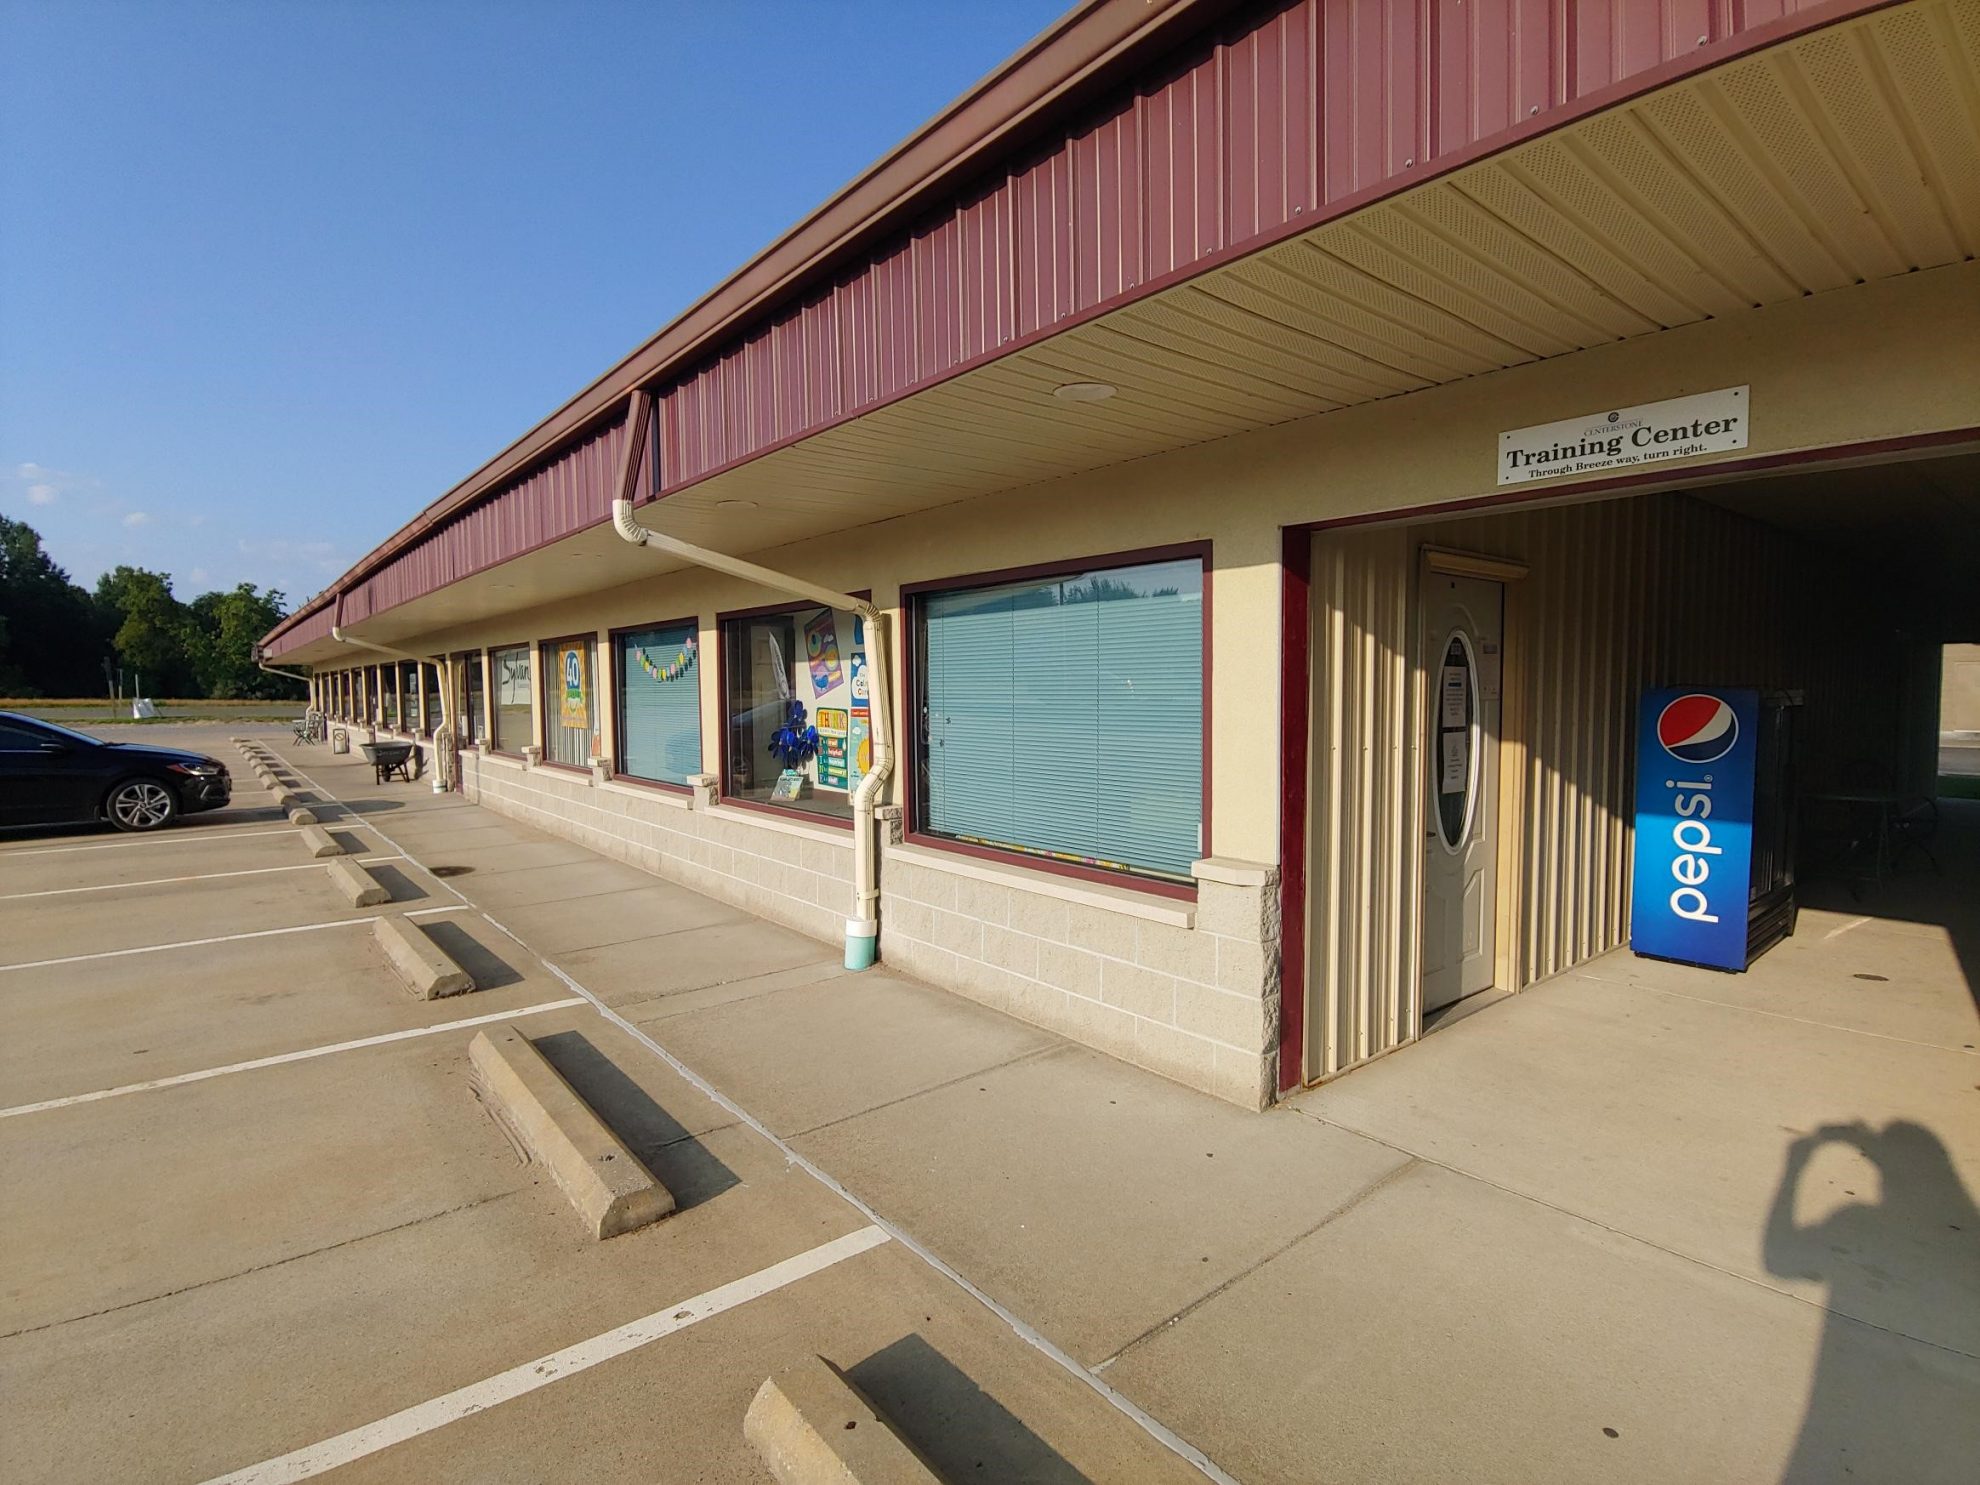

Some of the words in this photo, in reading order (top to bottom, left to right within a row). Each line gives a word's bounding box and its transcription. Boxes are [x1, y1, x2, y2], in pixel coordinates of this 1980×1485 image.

[1506, 435, 1624, 468] Training
[1631, 416, 1739, 447] Center
[1584, 420, 1643, 436] CENTERSTONE
[1528, 463, 1573, 478] Through
[1576, 457, 1613, 471] Breeze
[1616, 455, 1641, 465] way,
[1643, 449, 1669, 460] turn
[1673, 443, 1708, 456] right.
[566, 657, 580, 687] 40
[1665, 779, 1723, 923] pepsi
